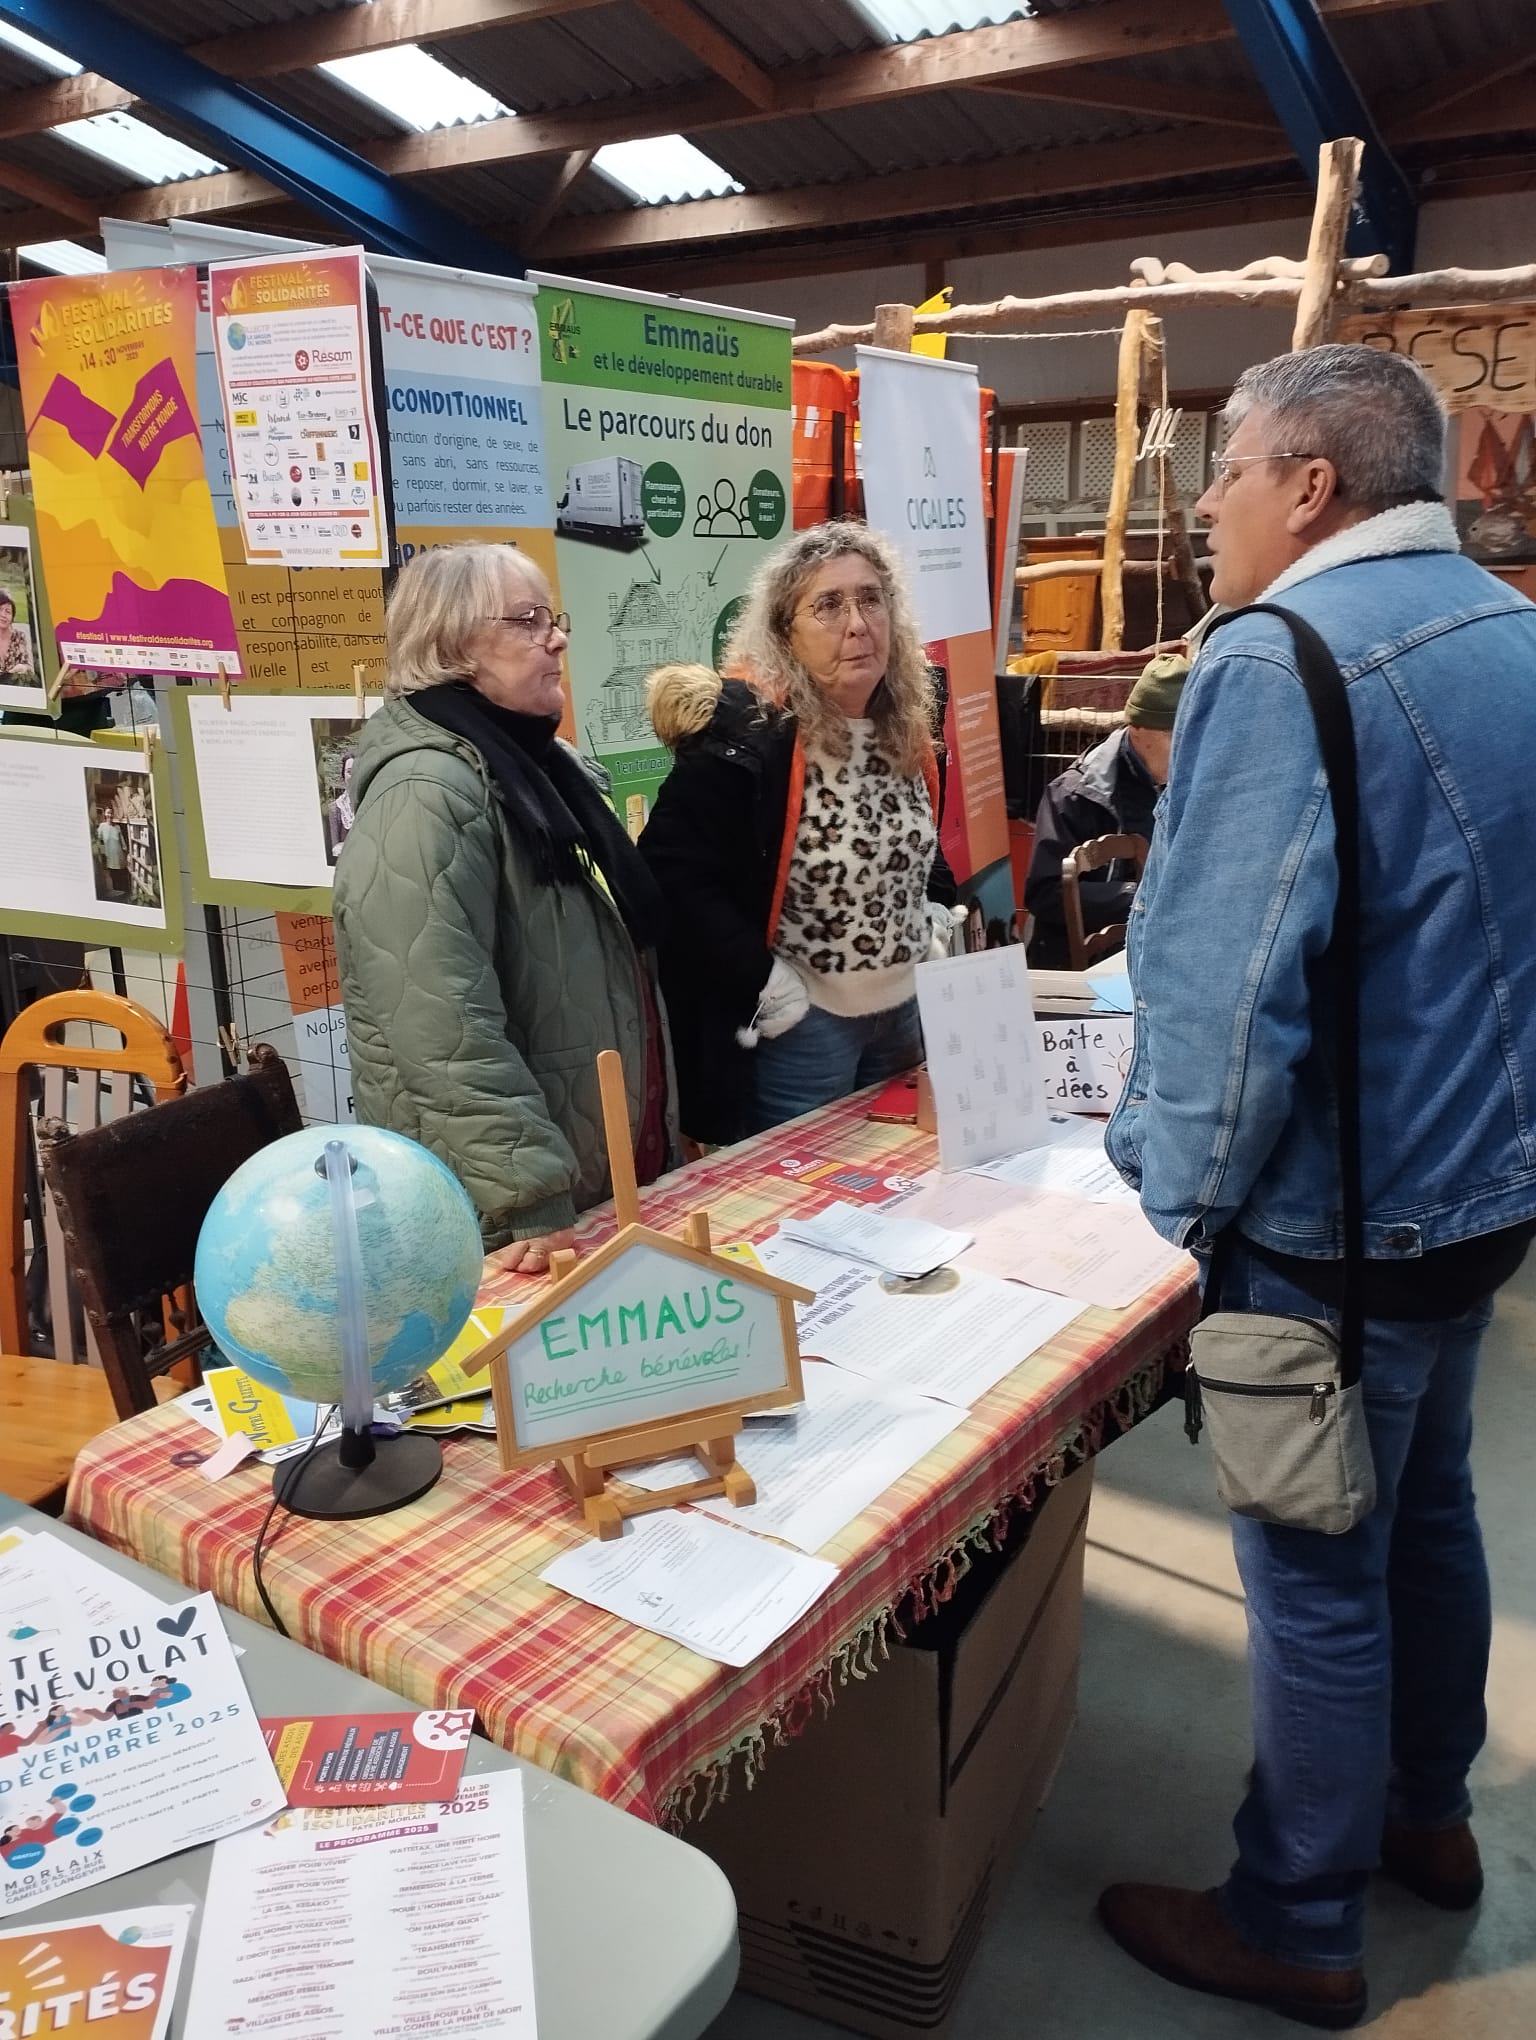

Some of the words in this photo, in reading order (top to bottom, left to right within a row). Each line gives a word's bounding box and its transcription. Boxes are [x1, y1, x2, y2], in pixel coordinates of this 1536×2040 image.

[256, 281, 330, 304] SOLIDARITÉS
[60, 289, 131, 328] FESTIVAL
[72, 300, 173, 349] SOLIDARITÉS
[430, 318, 468, 345] QUE
[472, 323, 517, 350] C'EST
[521, 329, 532, 353] ?
[644, 313, 740, 358] Emmaüs
[82, 352, 96, 370] 14
[104, 347, 117, 366] 30
[594, 353, 609, 370] et
[612, 351, 624, 371] le
[629, 356, 734, 385] développement
[736, 370, 783, 393] durable
[121, 388, 164, 449] TRANSFORMONS
[138, 418, 160, 452] NOTRE
[156, 396, 179, 428] MONDE
[563, 398, 592, 431] Le
[600, 409, 695, 441] parcours
[702, 413, 729, 444] du
[736, 416, 772, 448] don
[434, 434, 481, 450] d'origine,
[486, 437, 497, 448] de
[528, 441, 538, 452] de
[403, 456, 425, 467] sans
[434, 456, 456, 469] abri,
[466, 459, 488, 470] sans
[406, 479, 447, 494] reposer,
[452, 479, 489, 493] dormir,
[495, 482, 504, 494] se
[408, 500, 441, 516] parfois
[443, 502, 473, 513] rester
[476, 503, 493, 513] des
[238, 591, 245, 604] Il
[252, 592, 272, 604] est
[277, 587, 338, 607] personnel
[343, 589, 354, 600] et
[242, 617, 256, 629] et
[272, 613, 345, 629] compagnon
[358, 609, 371, 623] de
[246, 635, 341, 656] responsabilité,
[344, 635, 369, 647] dans
[250, 664, 287, 678] Il/elle
[312, 660, 330, 673] est
[306, 1018, 346, 1038] Nous
[1042, 1023, 1106, 1052] Boîte
[1066, 1056, 1080, 1073] à
[541, 1279, 745, 1361] EMMAUS
[523, 1369, 628, 1408] Recherche
[9, 1647, 60, 1681] TE
[89, 1625, 142, 1659] DU
[0, 1632, 208, 1717] NÉVOLAT
[0, 1731, 162, 1794] DÉCEMBRE
[173, 1703, 241, 1737] 2025
[22, 1710, 175, 1769] VENDREDI
[439, 1798, 490, 1816] 2025
[388, 1813, 427, 1825] MORLAIX
[319, 1841, 331, 1849] LE
[333, 1829, 401, 1847] PROGRAMME
[5, 1849, 103, 1891] MORLAIX
[84, 1859, 104, 1868] RUE
[6, 1886, 50, 1905] CAMILLE
[54, 1864, 106, 1887] LANGEVIN
[246, 2015, 282, 2028] VILLAGE
[284, 2011, 301, 2019] DES
[403, 2020, 440, 2032] CONTRE
[484, 2010, 495, 2018] DE
[433, 2010, 459, 2020] POUR
